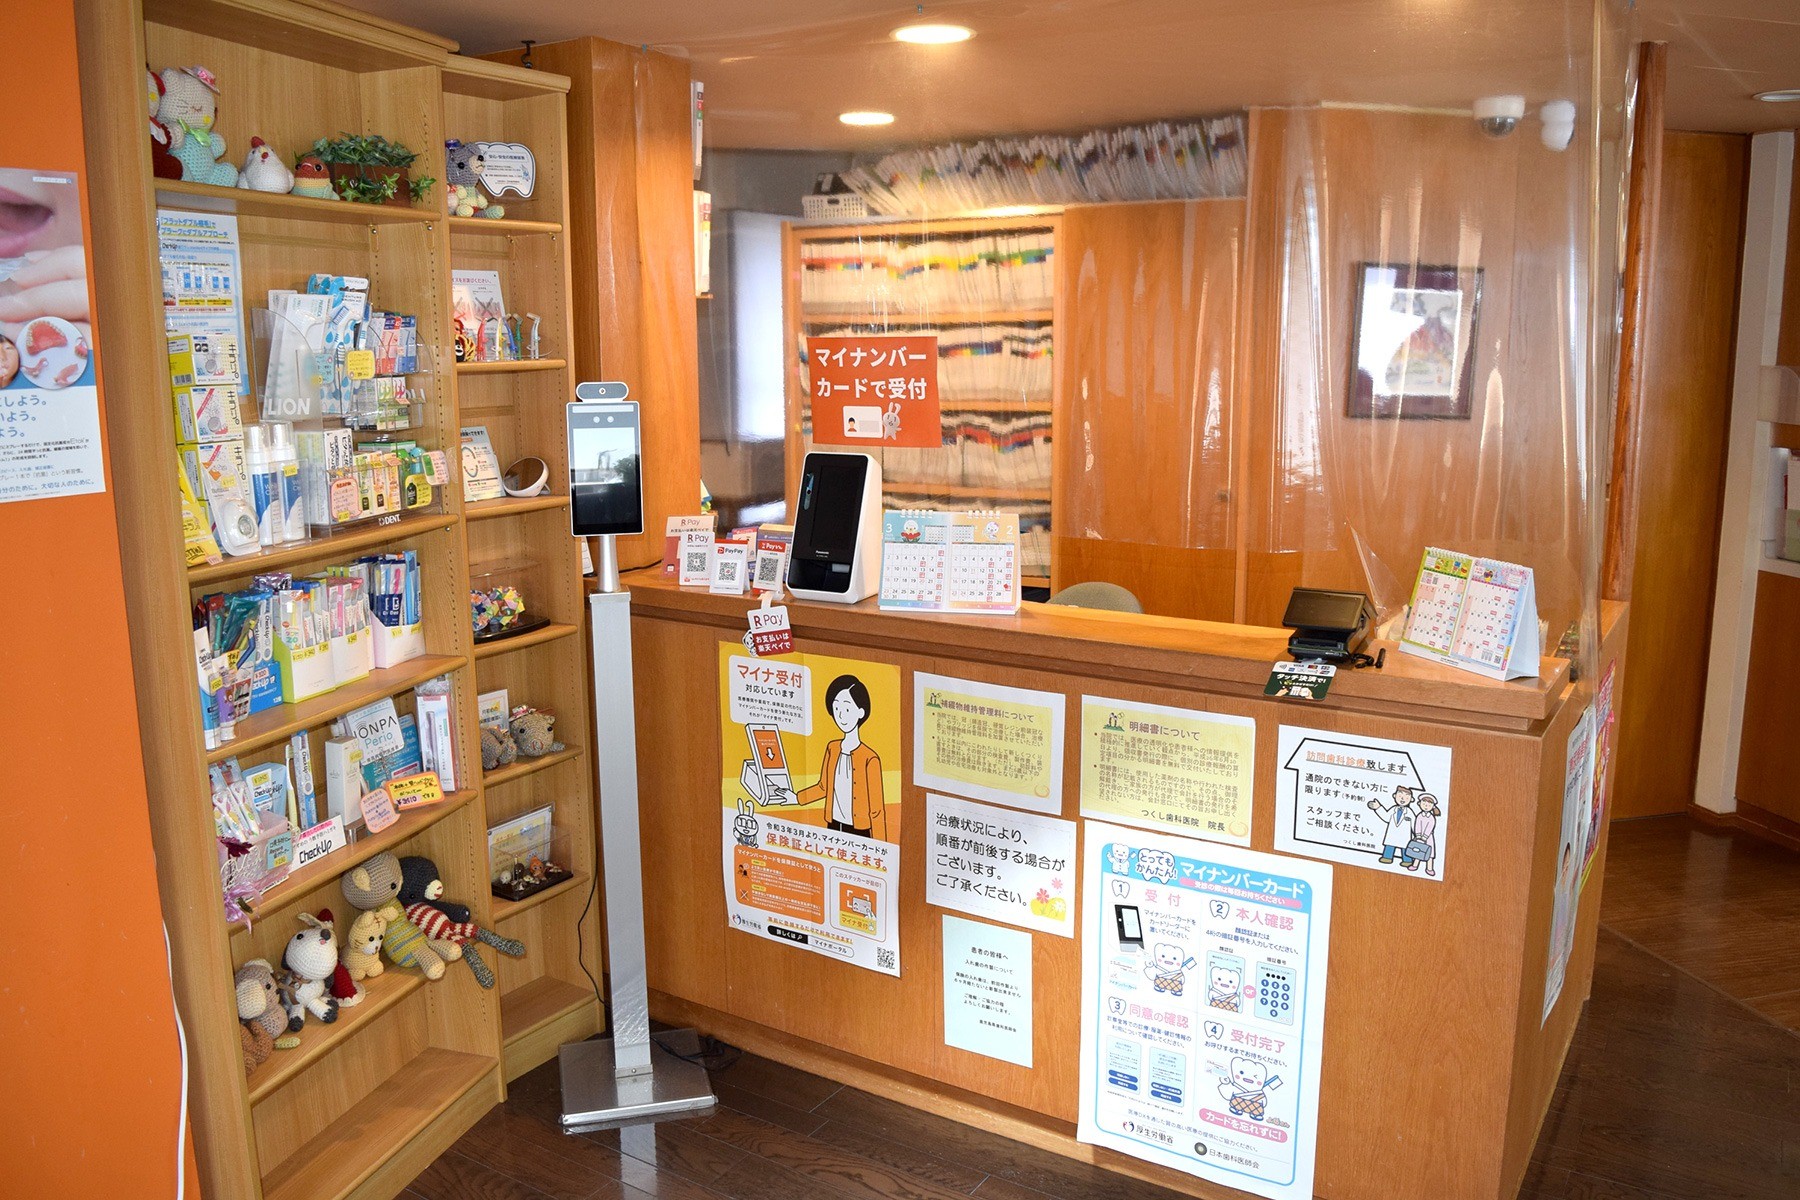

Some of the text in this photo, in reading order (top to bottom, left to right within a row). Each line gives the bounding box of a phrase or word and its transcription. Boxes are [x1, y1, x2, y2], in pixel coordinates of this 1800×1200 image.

[815, 346, 926, 367] マイナンバー
[817, 377, 927, 399] カードで受付
[0, 394, 46, 407] しよう。
[268, 398, 310, 415] LION
[886, 523, 893, 533] 3
[1006, 525, 1013, 535] 2
[695, 534, 709, 543] Pay
[763, 614, 783, 627] Pay
[755, 633, 789, 643] お支払いは
[758, 641, 791, 652] 楽天ペイで
[737, 664, 803, 689] マイナ受付
[745, 684, 795, 699] 対応しています
[941, 699, 1034, 722] 補綴物維持管理料について
[364, 731, 393, 749] Perio
[1129, 721, 1200, 741] 明細書について
[1306, 750, 1408, 773] 訪問歯科診療致します
[1305, 772, 1389, 793] 通院のできない方に
[1098, 793, 1119, 802] ださい。
[1141, 809, 1225, 832] つくし歯科医院 院長
[1306, 805, 1361, 821] スタッフまで
[936, 812, 1027, 845] 治療状況により、
[1306, 817, 1374, 837] ご相談ください。
[766, 822, 888, 856] 令和3年3月より、マイナンバーカードが
[299, 840, 332, 864] Check-Up
[766, 833, 888, 871] 保険証として使えます。
[935, 832, 1065, 871] 順番が前後する場合が
[1140, 852, 1174, 867] とっても
[936, 853, 1001, 880] ございます。
[936, 873, 1027, 906] ご了承ください。
[1118, 884, 1123, 894] 1
[1180, 861, 1306, 900] マイナンバーカード
[1144, 909, 1197, 926] マイナンバーカードを
[1216, 904, 1223, 914] 2
[841, 916, 868, 930] マイナ受付
[1236, 908, 1294, 931] 本人確認
[776, 928, 796, 940] 詳しくは
[814, 940, 847, 954] マイナポータル
[971, 946, 1009, 960] 患者の皆様へ
[1115, 1001, 1121, 1010] 3
[1129, 1003, 1189, 1029] 同意の確認
[1211, 1026, 1217, 1034] 4
[1231, 1028, 1286, 1054] 受付完了
[1136, 1124, 1174, 1144] 厚生労働省
[1209, 1149, 1260, 1169] 日本歯科医師会
